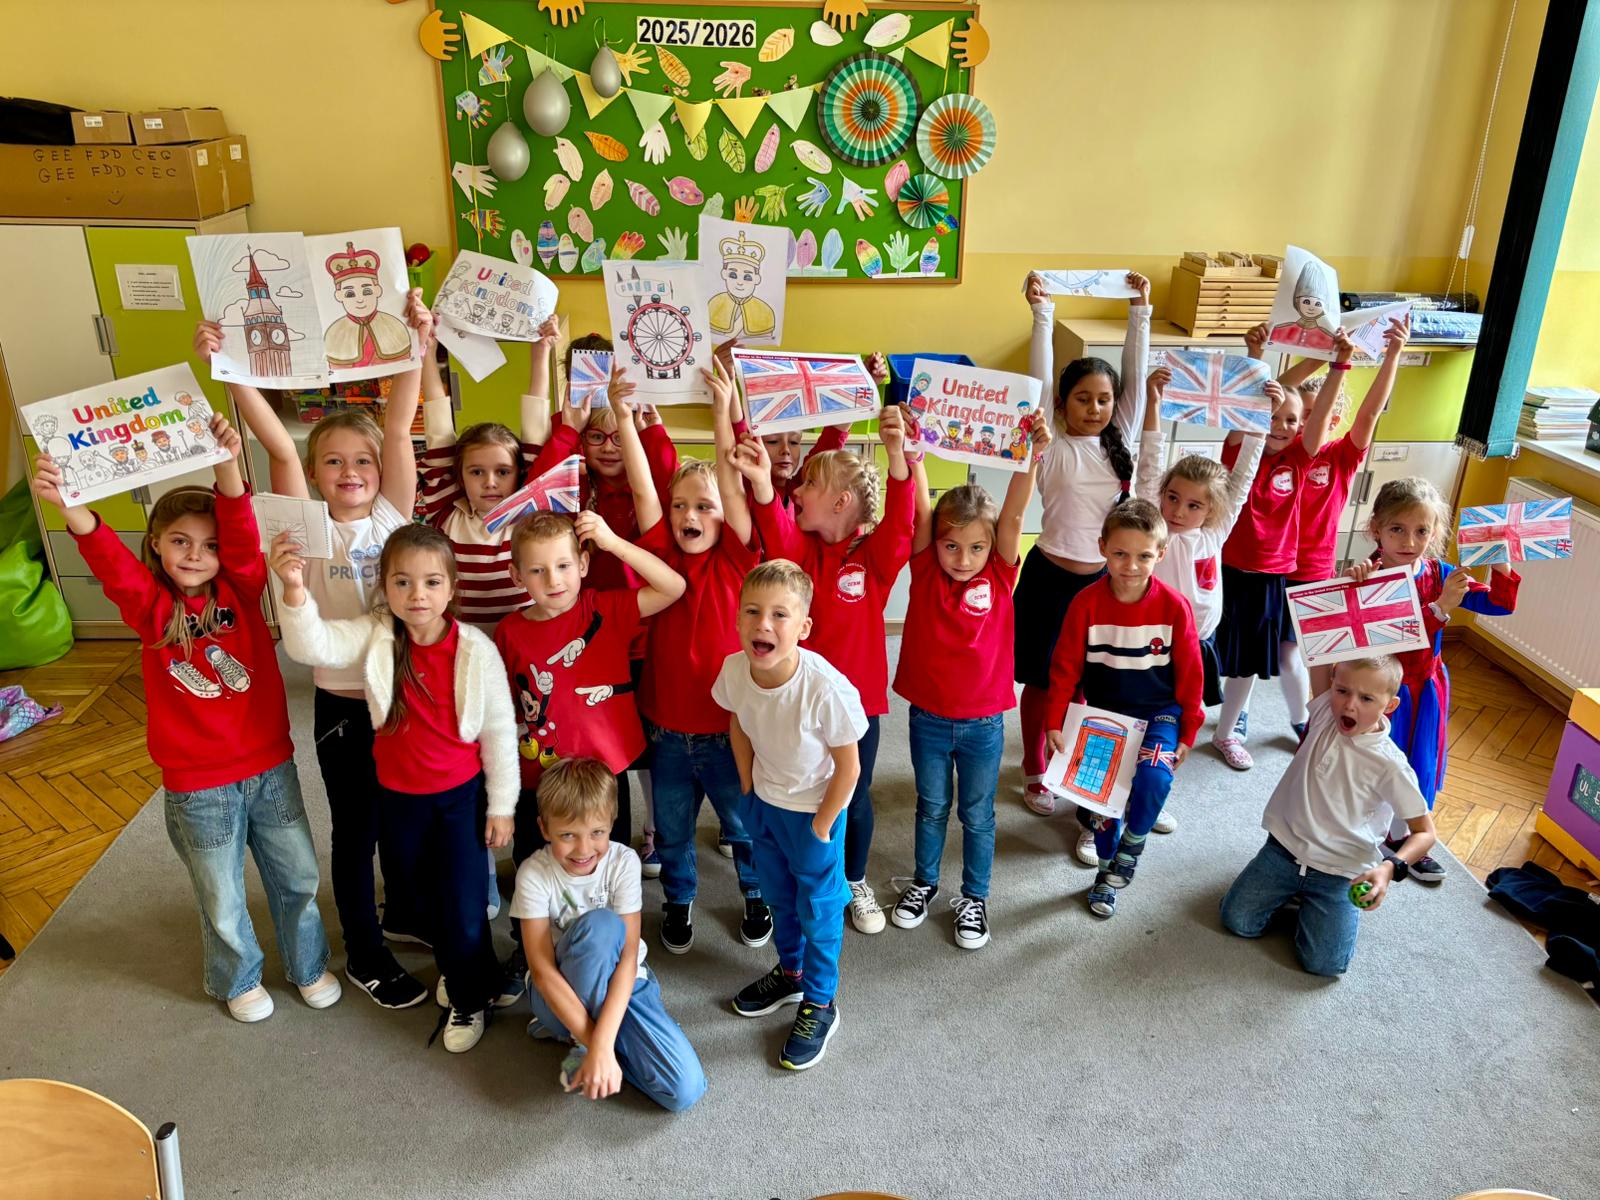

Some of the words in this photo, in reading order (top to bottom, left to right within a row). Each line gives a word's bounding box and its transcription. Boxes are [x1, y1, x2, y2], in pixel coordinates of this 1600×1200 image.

[639, 19, 754, 47] 2025/2026
[477, 267, 535, 296] United
[461, 279, 535, 317] Kingdom
[72, 387, 161, 424] United
[942, 377, 1009, 405] United
[927, 398, 1015, 428] Kingdom
[68, 407, 186, 450] Kingdom
